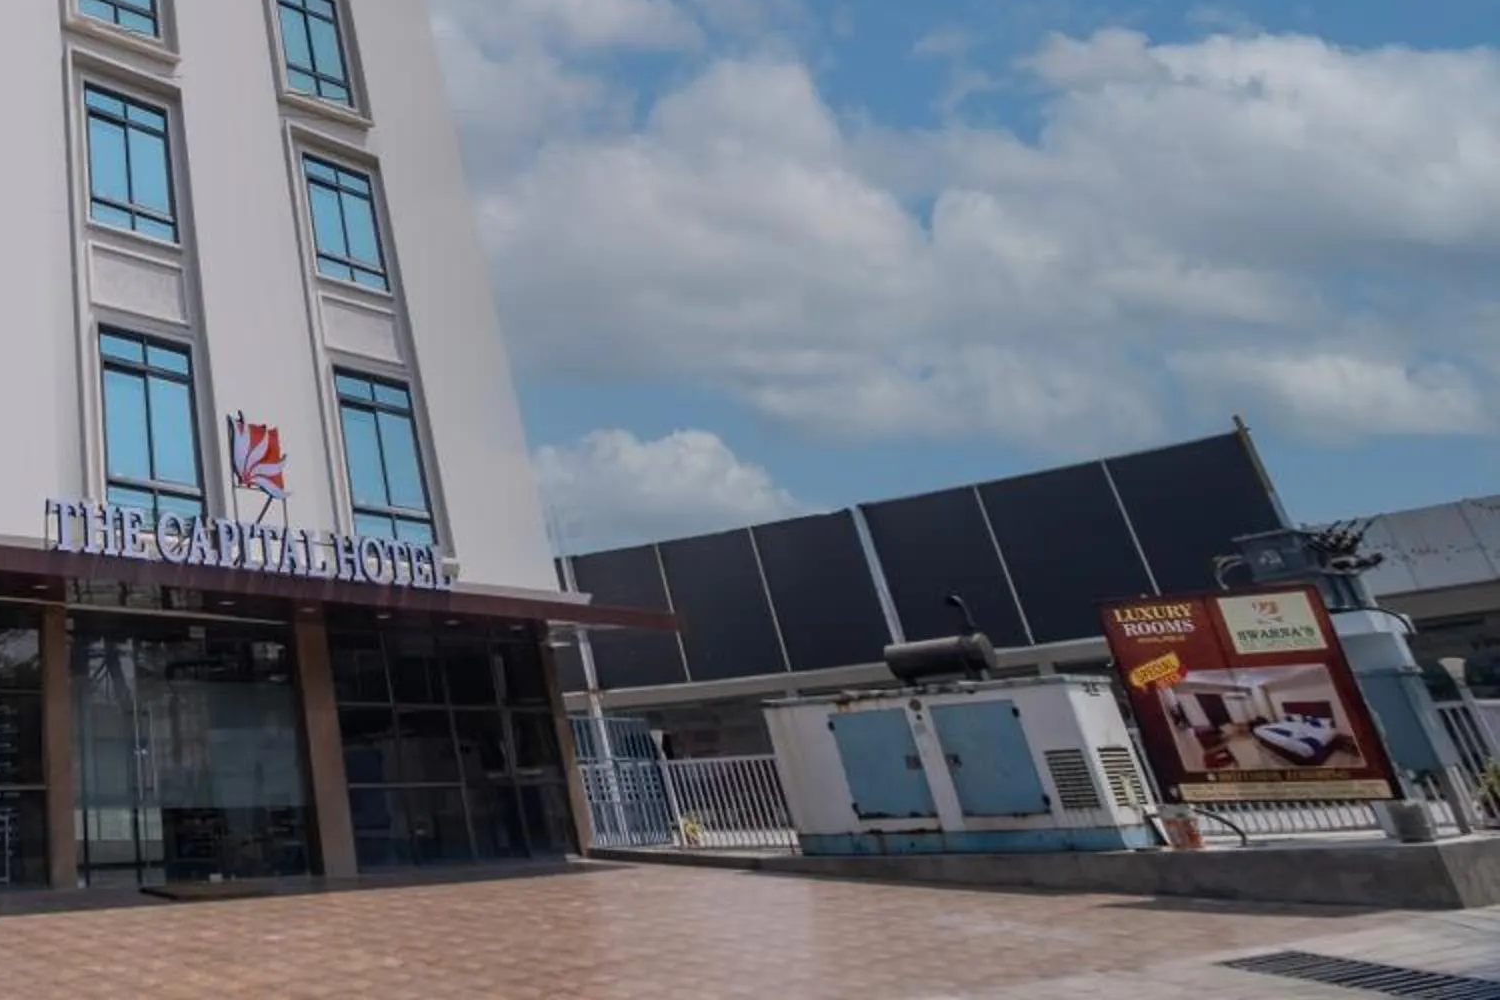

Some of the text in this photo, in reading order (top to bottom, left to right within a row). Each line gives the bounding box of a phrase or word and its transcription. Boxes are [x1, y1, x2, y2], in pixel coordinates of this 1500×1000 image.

[53, 500, 456, 592] THE CAPITAL HOTEL
[1113, 603, 1193, 623] LUXURY
[1123, 619, 1196, 637] ROOMS
